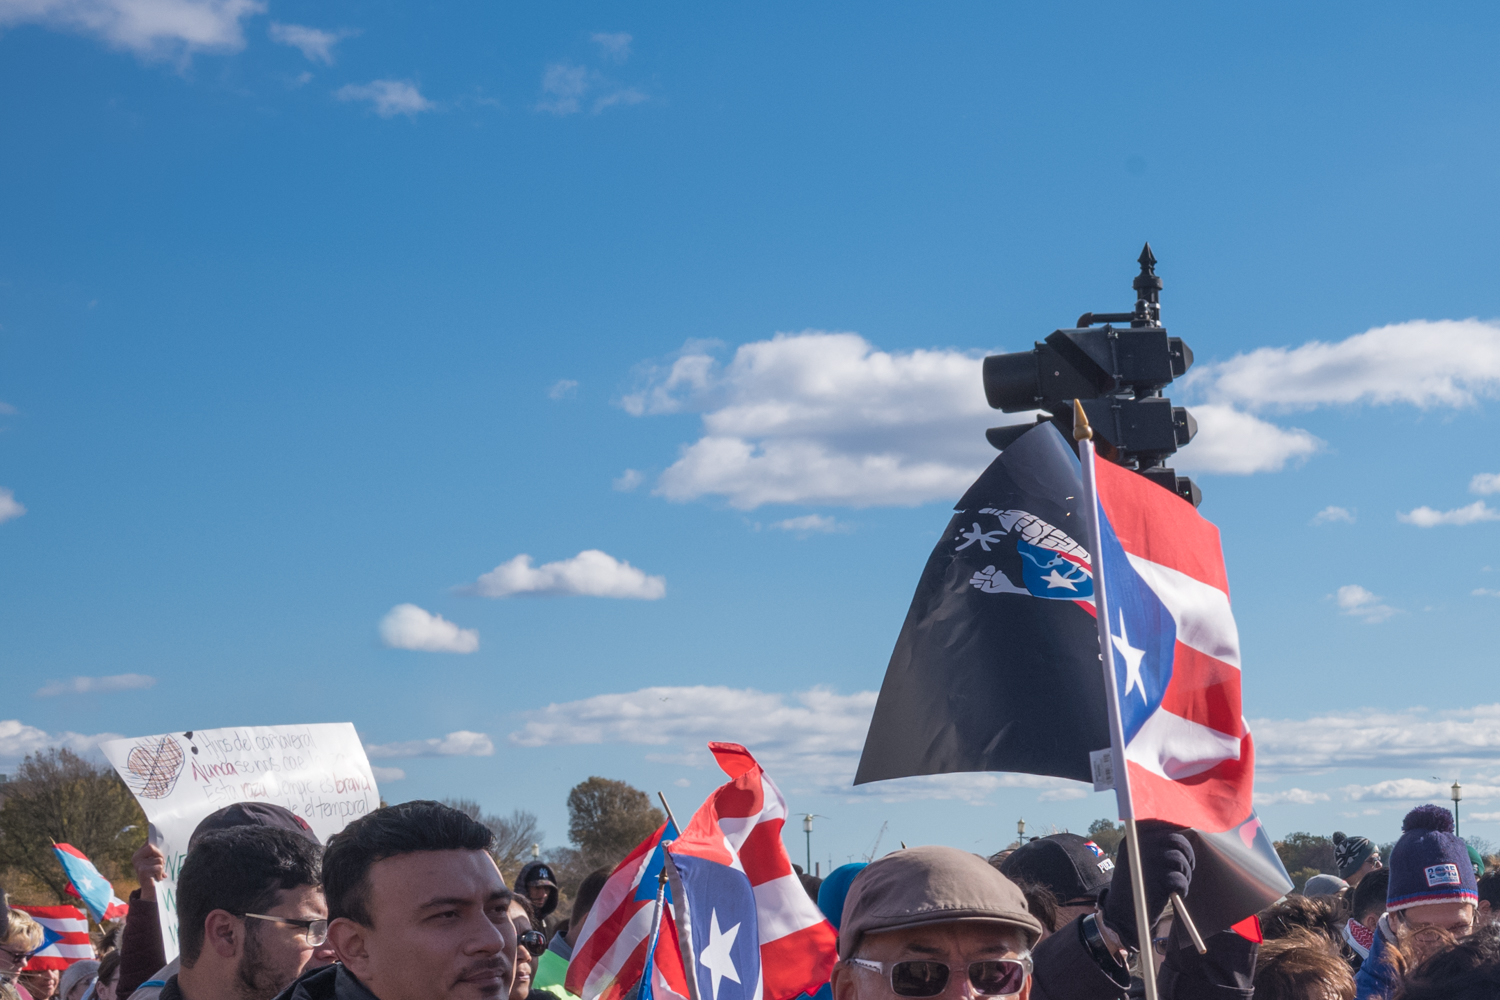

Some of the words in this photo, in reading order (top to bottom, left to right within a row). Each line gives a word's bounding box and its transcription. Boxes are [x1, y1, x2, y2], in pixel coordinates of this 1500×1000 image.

[234, 731, 253, 751] del
[191, 757, 239, 783] Nunca
[234, 759, 254, 773] se
[333, 773, 372, 794] brava
[304, 796, 315, 817] el
[316, 792, 370, 826] temporal
